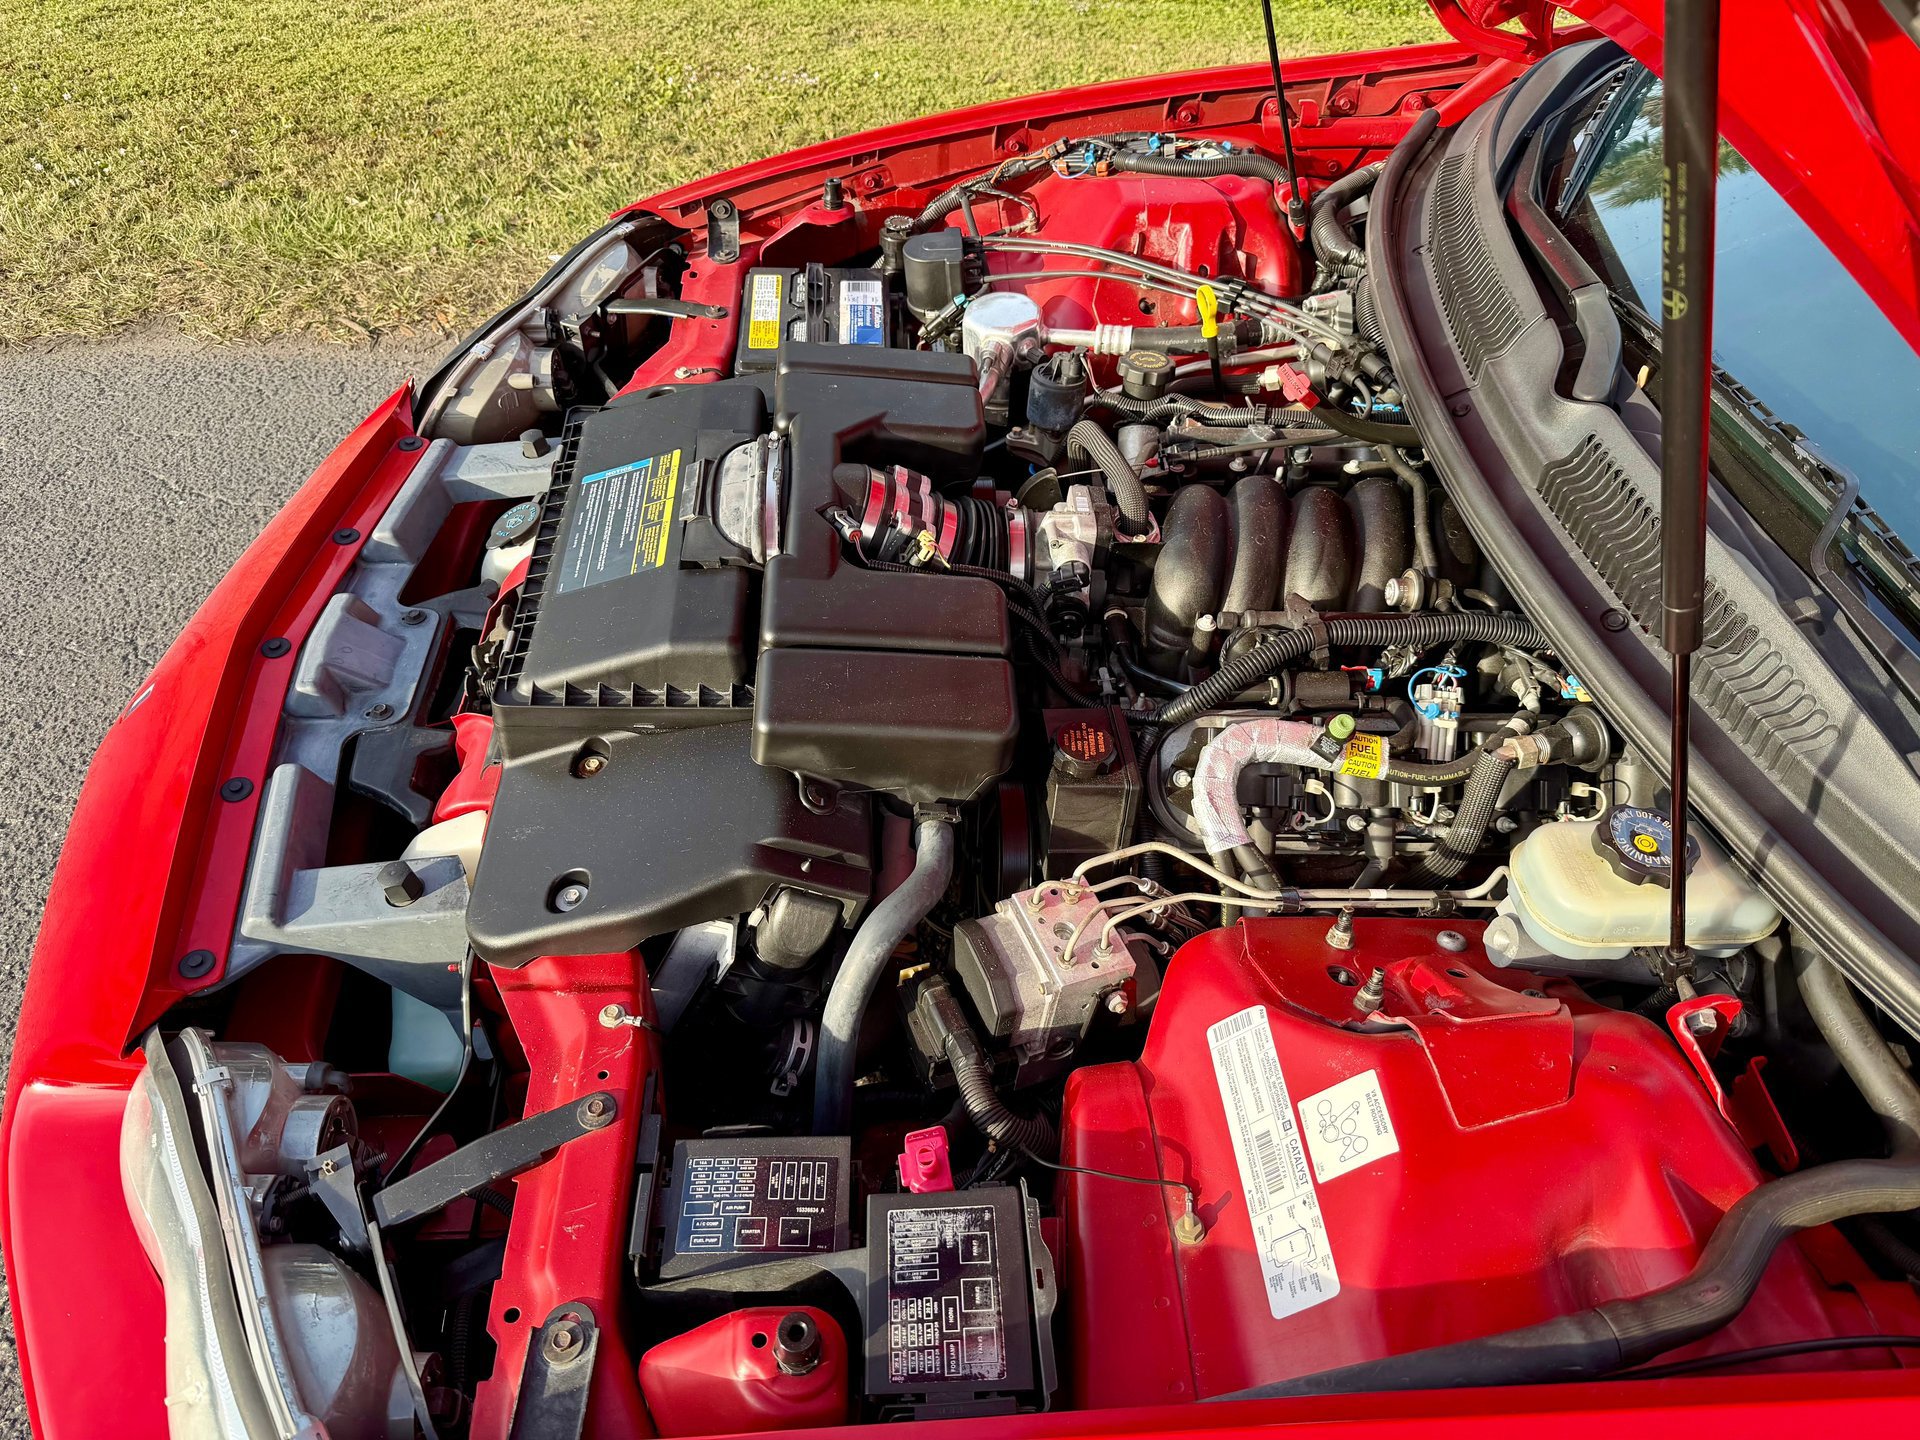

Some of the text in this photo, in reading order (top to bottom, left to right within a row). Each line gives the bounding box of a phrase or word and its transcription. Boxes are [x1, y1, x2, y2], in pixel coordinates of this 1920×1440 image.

[1087, 727, 1096, 755] STEERING
[1096, 731, 1104, 752] POWER
[1350, 742, 1376, 755] FUEL
[1354, 735, 1377, 743] AUTION
[1344, 767, 1371, 777] FUEL
[1348, 758, 1376, 769] CAUTION
[1618, 811, 1634, 822] ONLY
[1636, 811, 1653, 819] DOT
[1263, 1051, 1286, 1121] CONTROL INFORMATION
[1270, 1056, 1288, 1110] VEHICLE EMISSION
[1364, 1092, 1382, 1136] BELT ROUTING
[1370, 1089, 1389, 1134] V8 ACCESSORY
[1288, 1137, 1308, 1188] CATALYST
